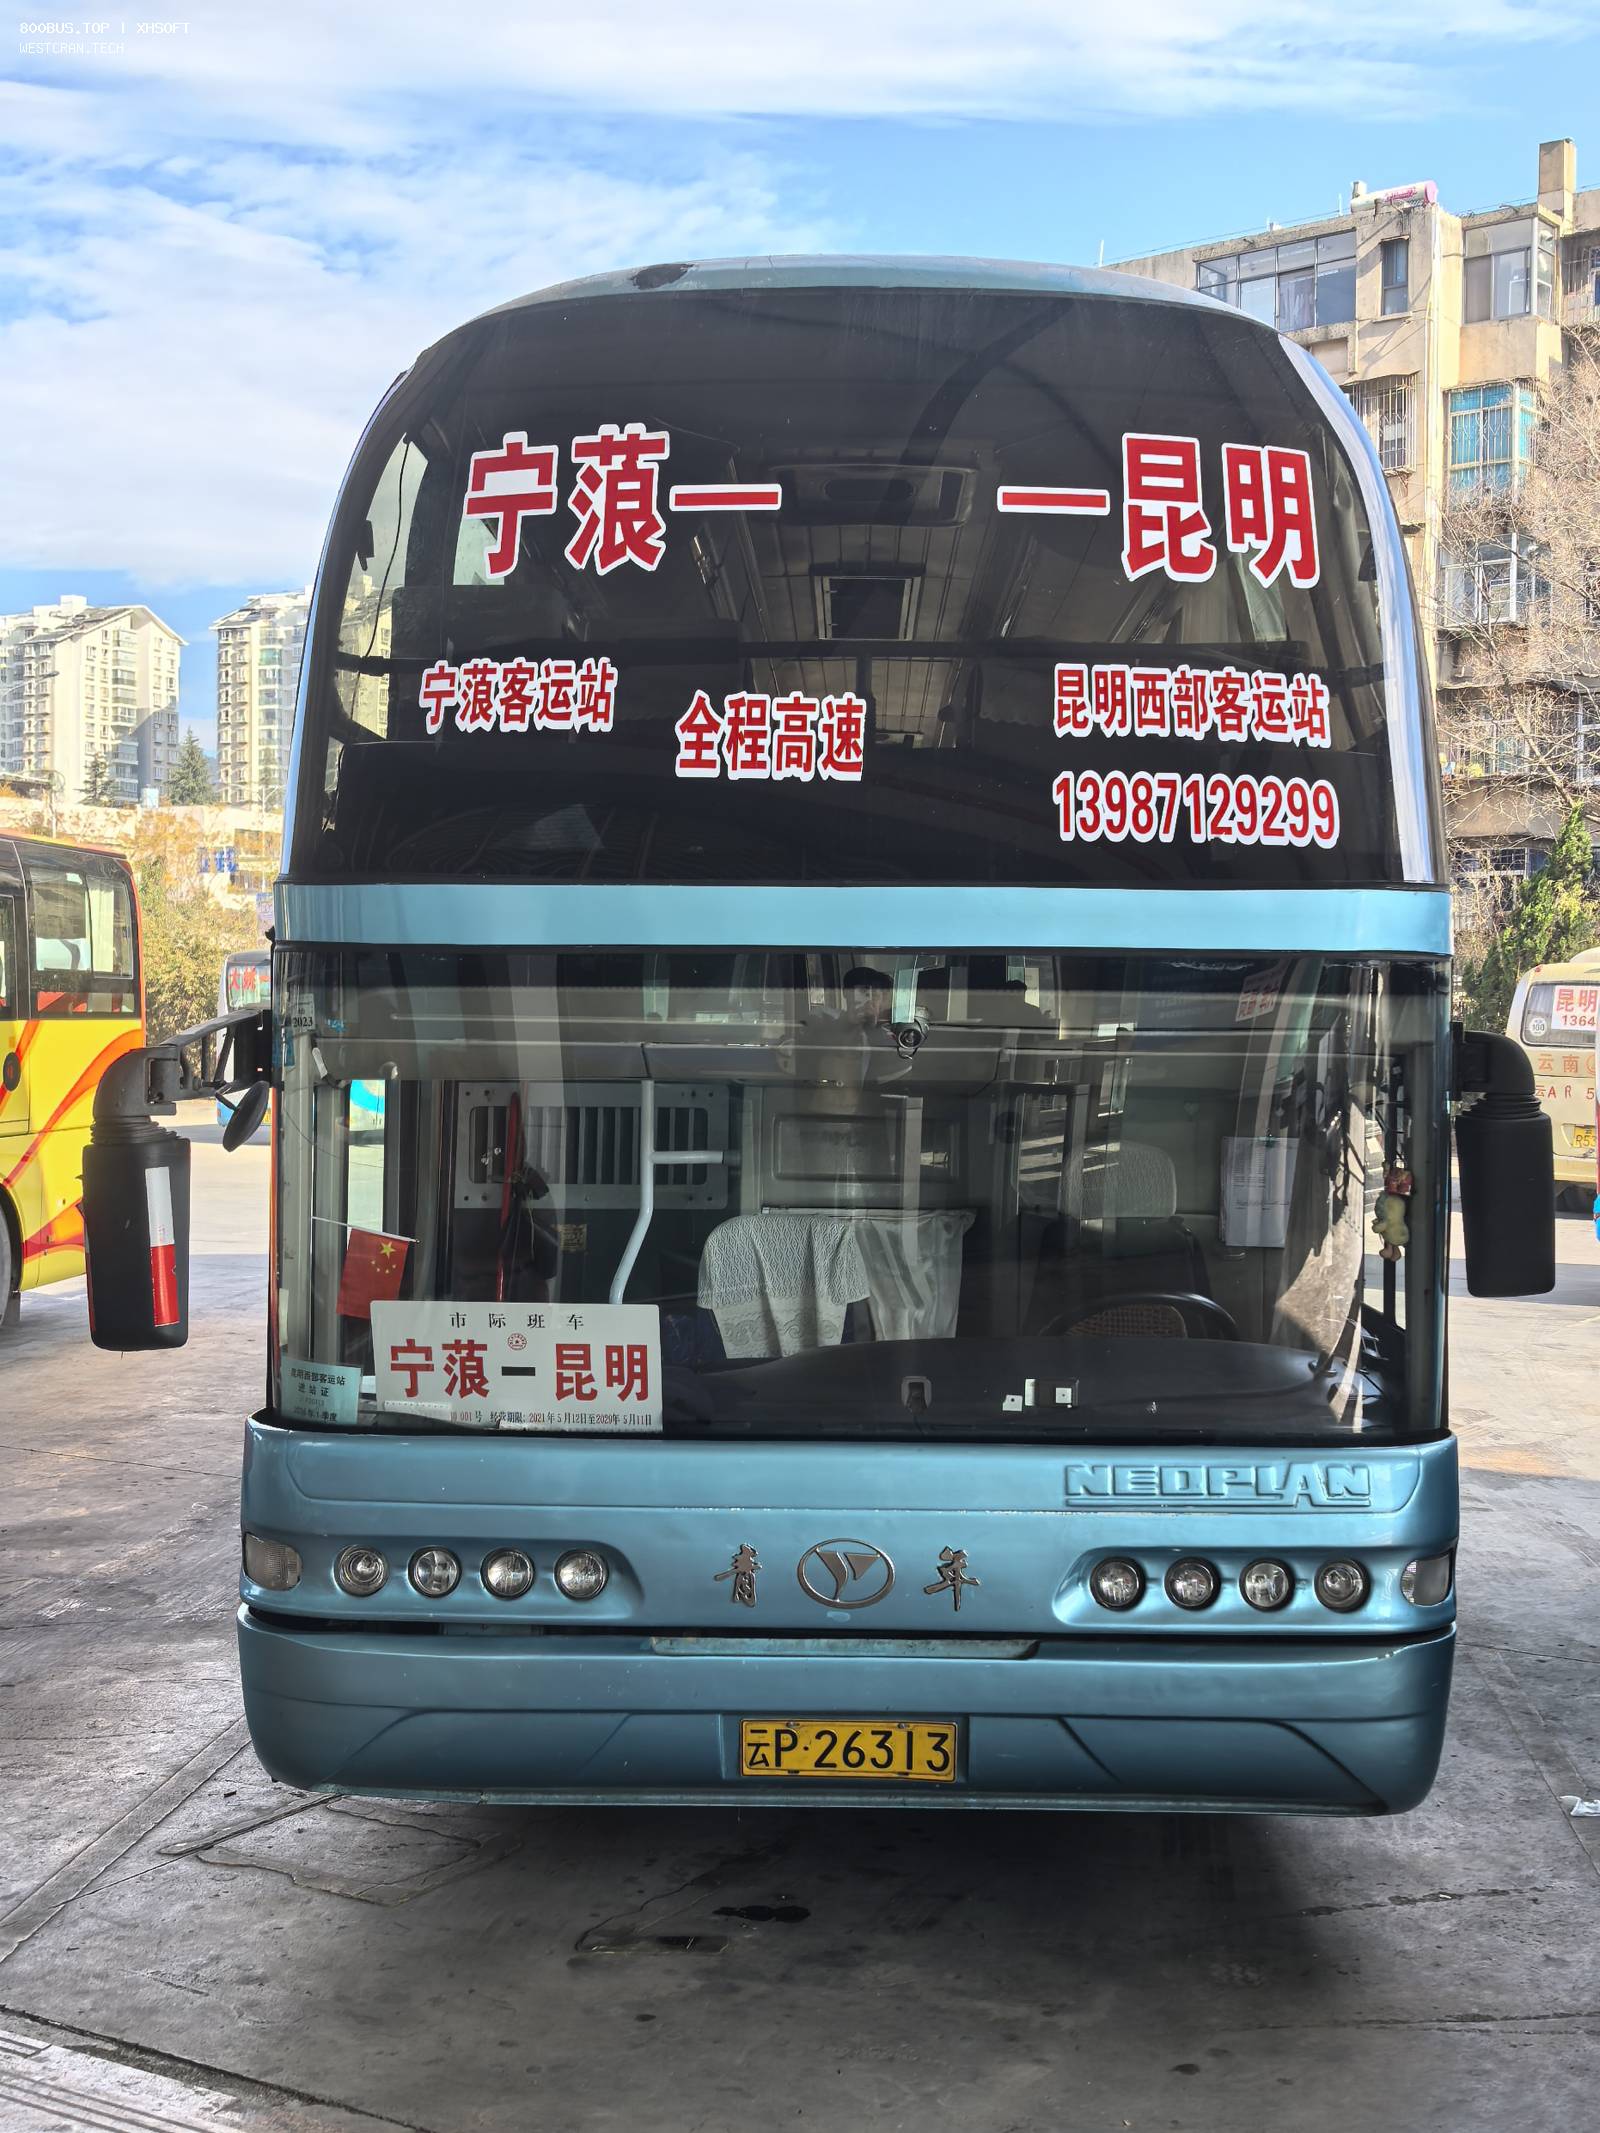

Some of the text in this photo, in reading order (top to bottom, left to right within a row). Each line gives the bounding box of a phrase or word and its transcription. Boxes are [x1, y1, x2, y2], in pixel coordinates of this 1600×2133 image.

[420, 657, 617, 733] 宁蒗客运站
[1054, 664, 1331, 747] 昆明西部客运站
[676, 691, 866, 780] 全程高速
[1054, 771, 1339, 848] 13987129299
[1556, 988, 1598, 1013] 昆明
[1538, 1053, 1580, 1073] 云南
[449, 1311, 585, 1331] 市际班车
[1065, 1463, 1371, 1506] NEOPLAN
